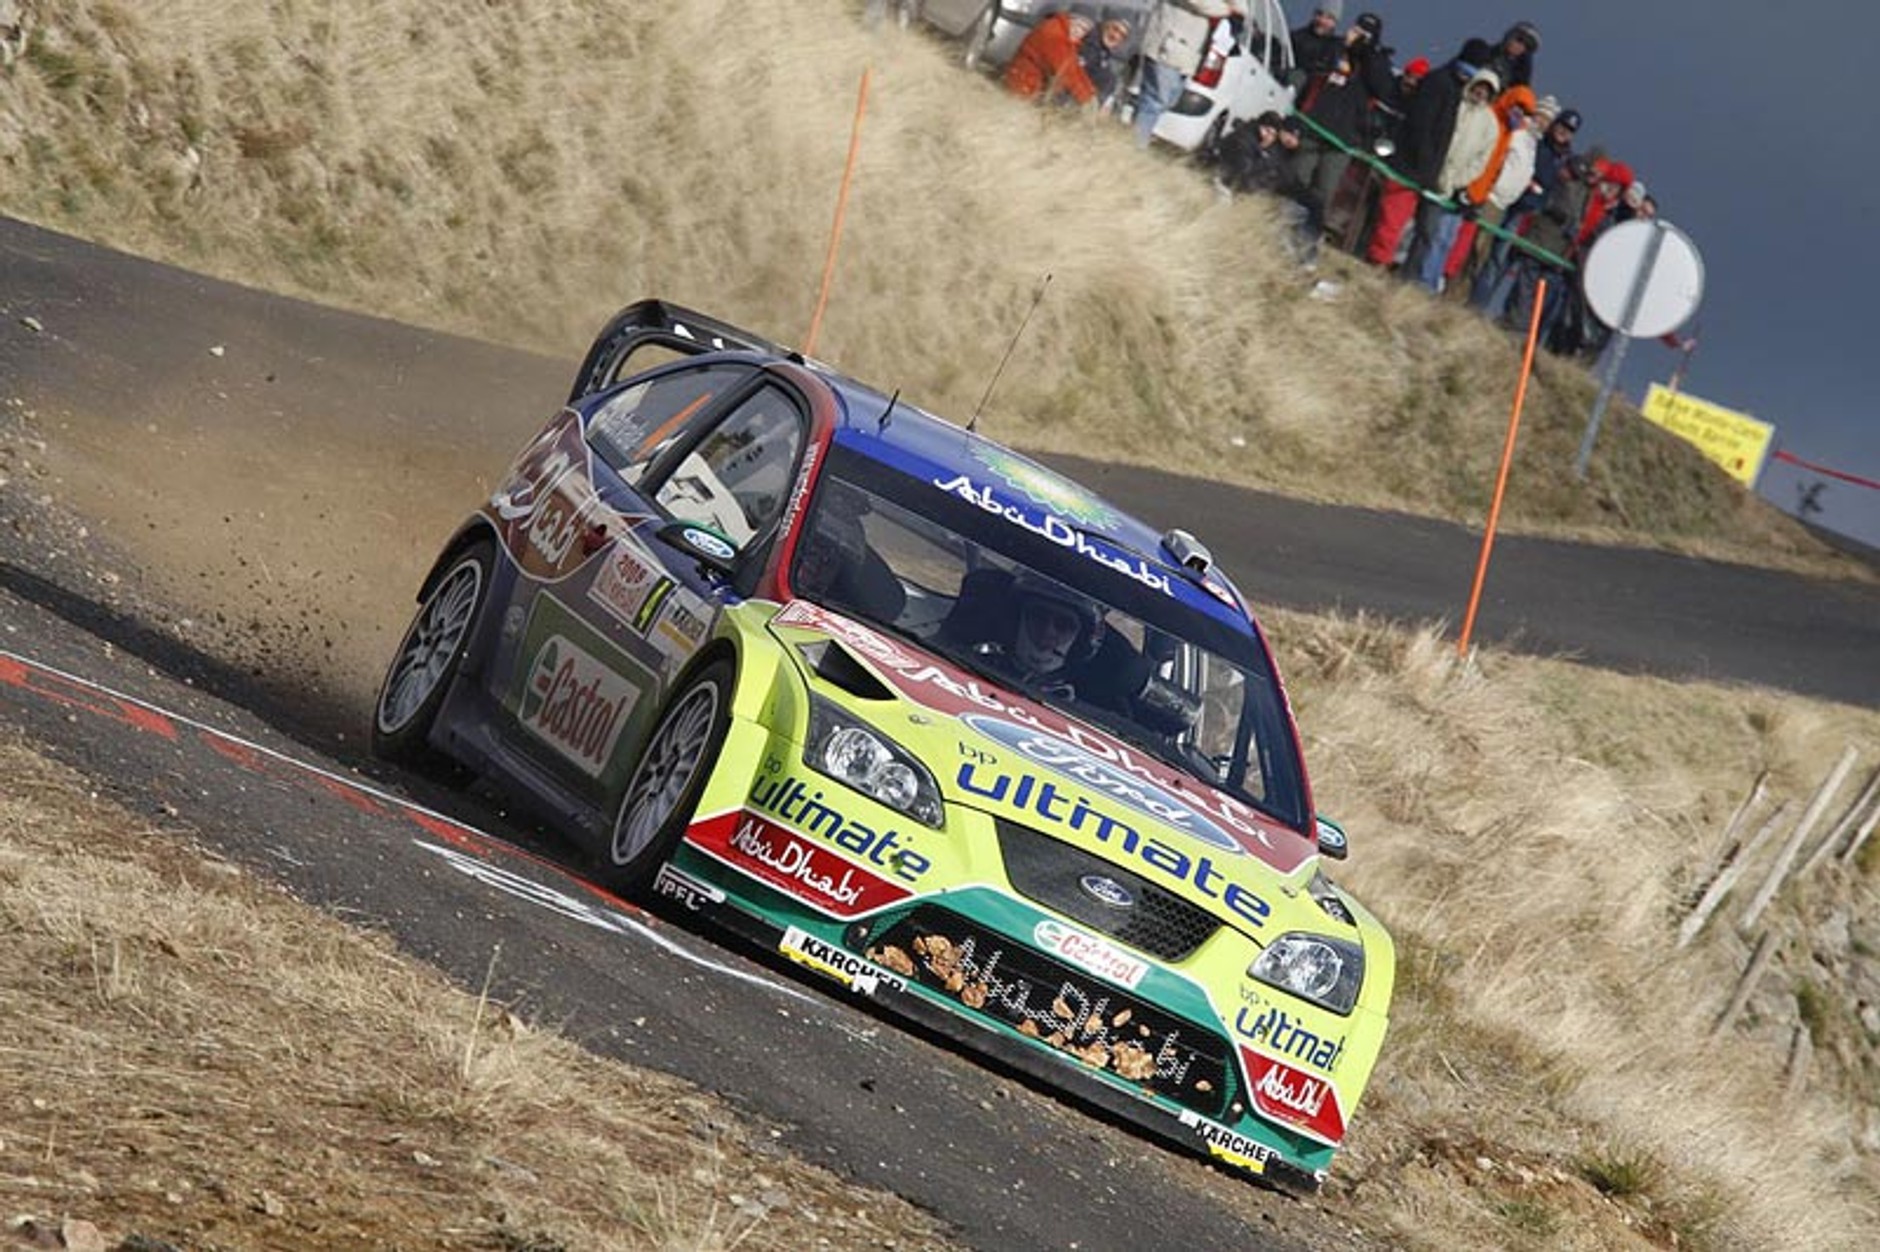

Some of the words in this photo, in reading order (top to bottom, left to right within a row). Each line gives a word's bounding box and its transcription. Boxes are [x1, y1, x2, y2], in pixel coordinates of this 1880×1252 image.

[537, 657, 628, 765] Castrol
[957, 740, 998, 766] bp
[752, 775, 931, 882] ultimate
[1018, 734, 1195, 829] Ford
[955, 763, 1272, 927] ultimate
[1060, 934, 1141, 984] Castrol
